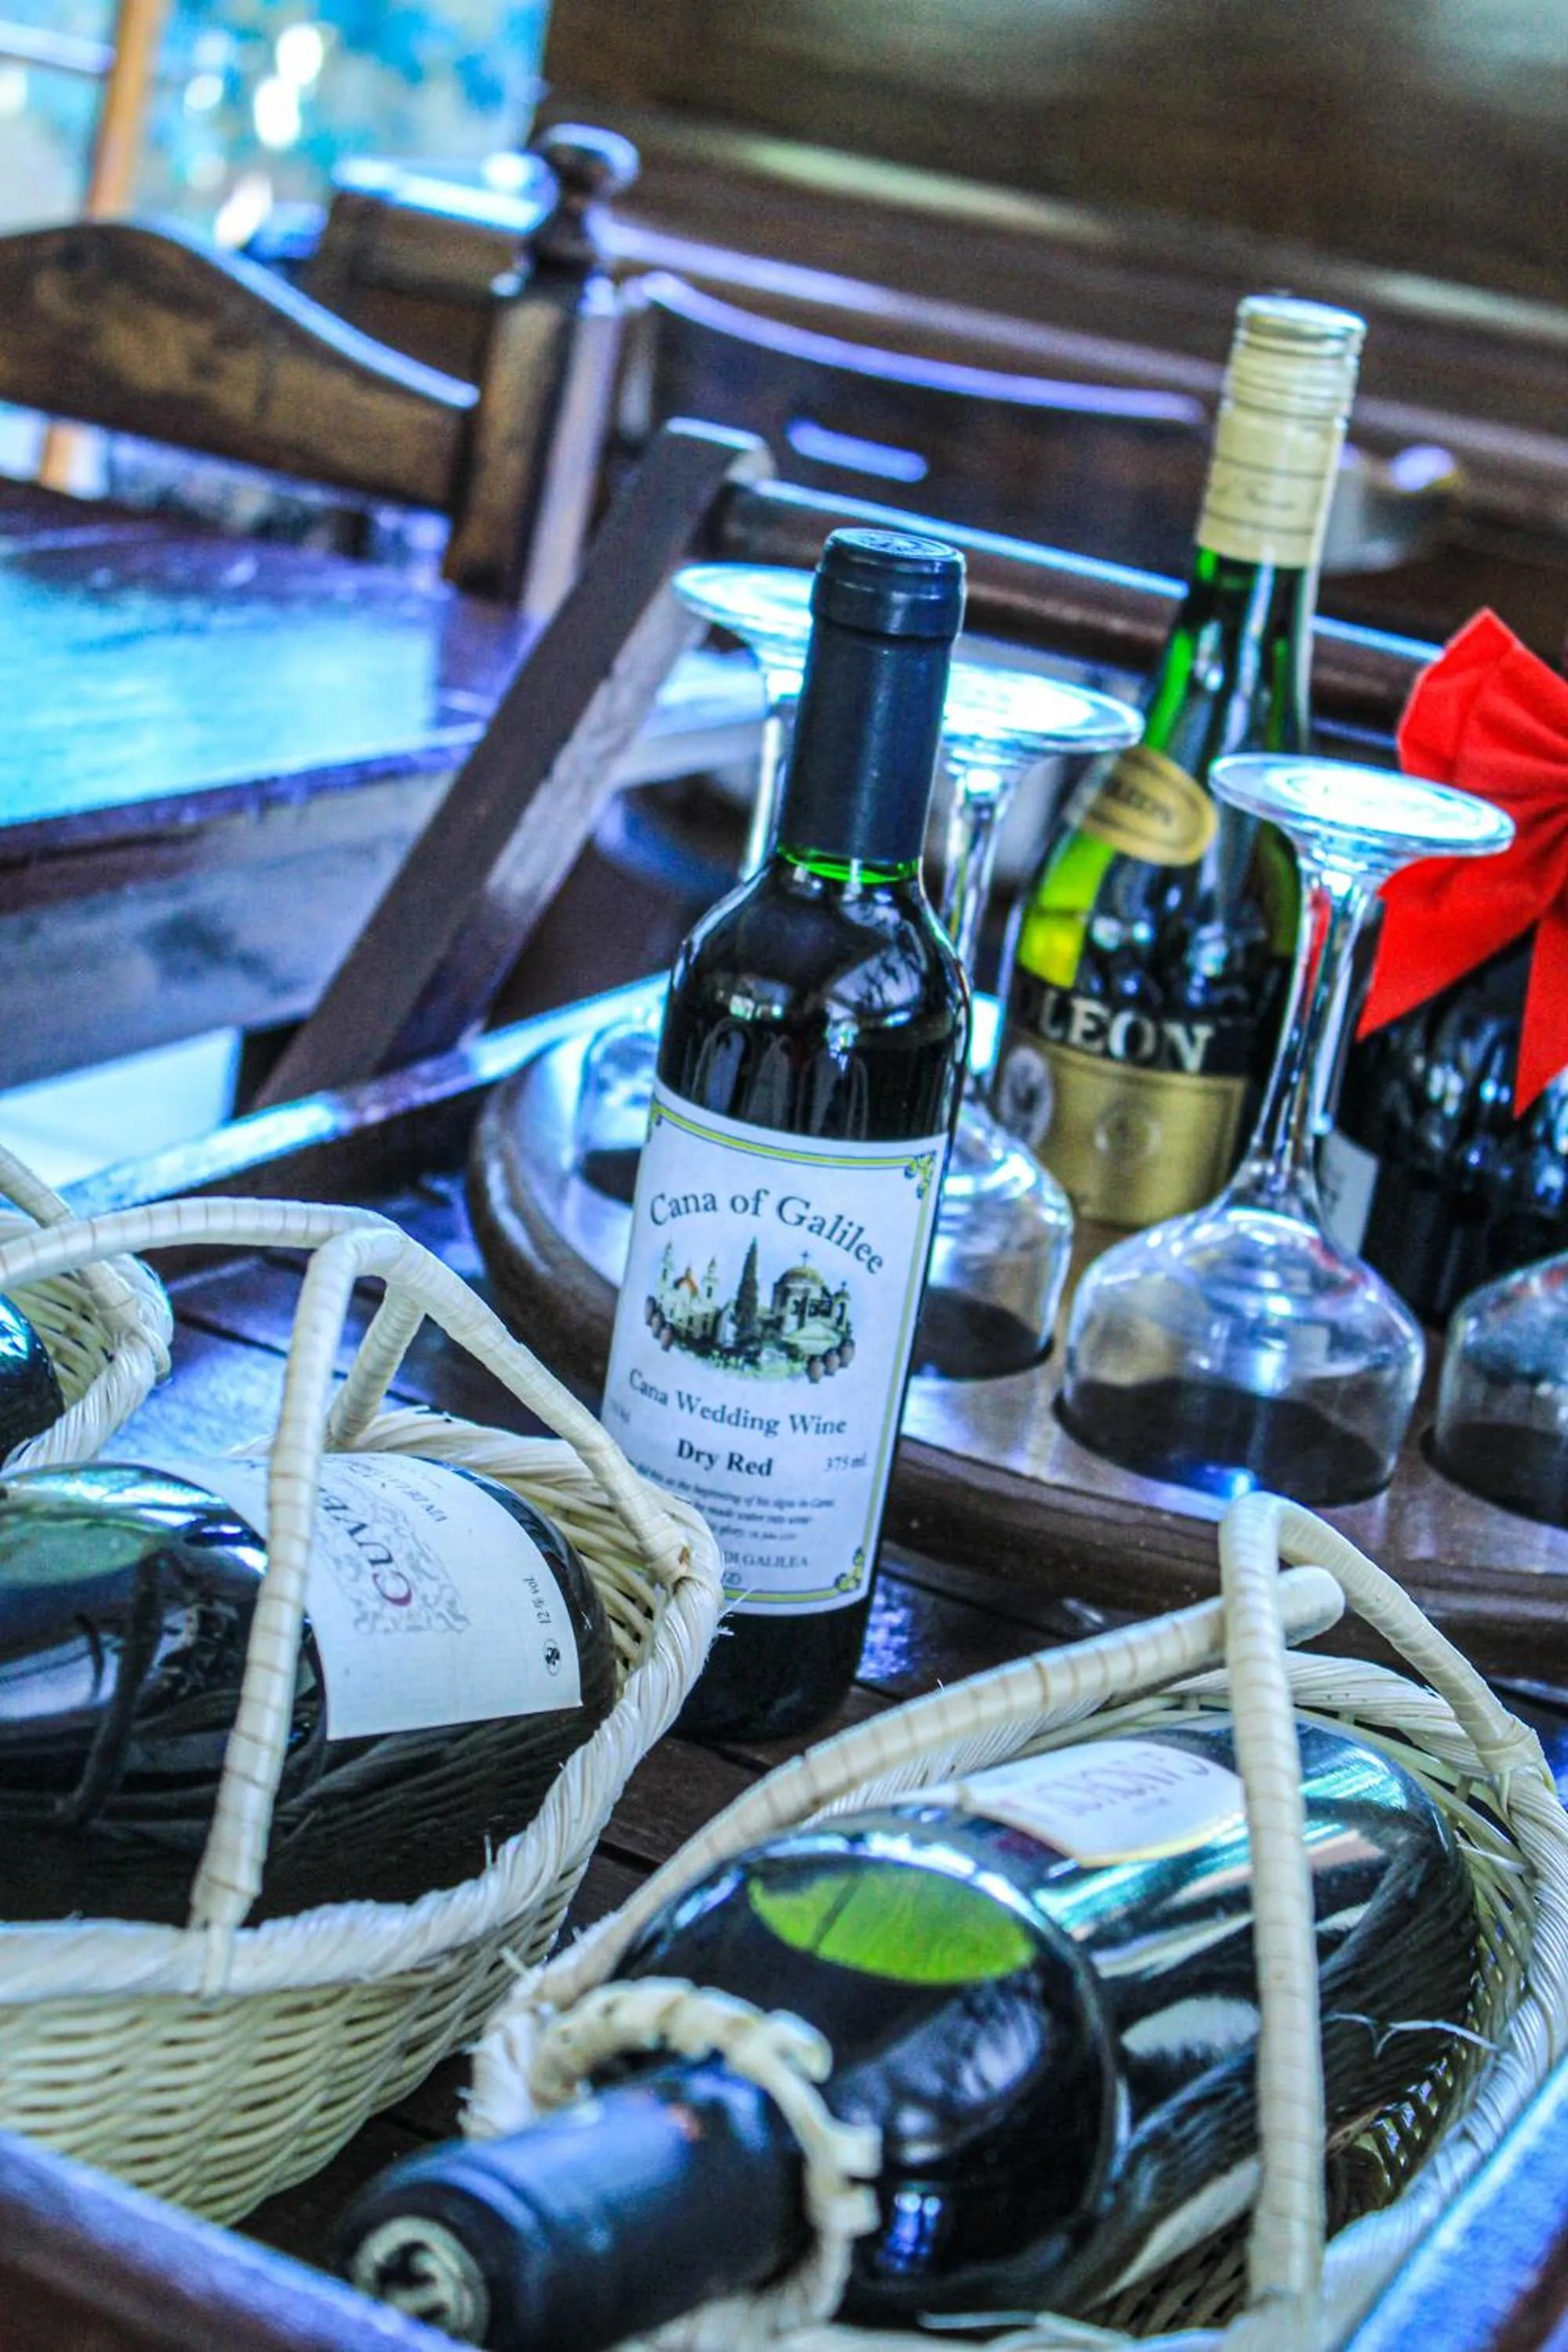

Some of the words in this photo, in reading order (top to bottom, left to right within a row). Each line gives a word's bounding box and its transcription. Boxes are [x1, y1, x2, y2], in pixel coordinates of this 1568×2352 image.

[650, 1191, 717, 1226] Cana
[730, 1189, 770, 1218] of
[775, 1196, 884, 1276] Galilee
[629, 1368, 669, 1406] Cana
[677, 1390, 781, 1438] Wedding
[789, 1413, 847, 1436] Wine
[677, 1438, 720, 1472] Dry
[727, 1451, 773, 1477] Red
[317, 1485, 412, 1606] CUVE
